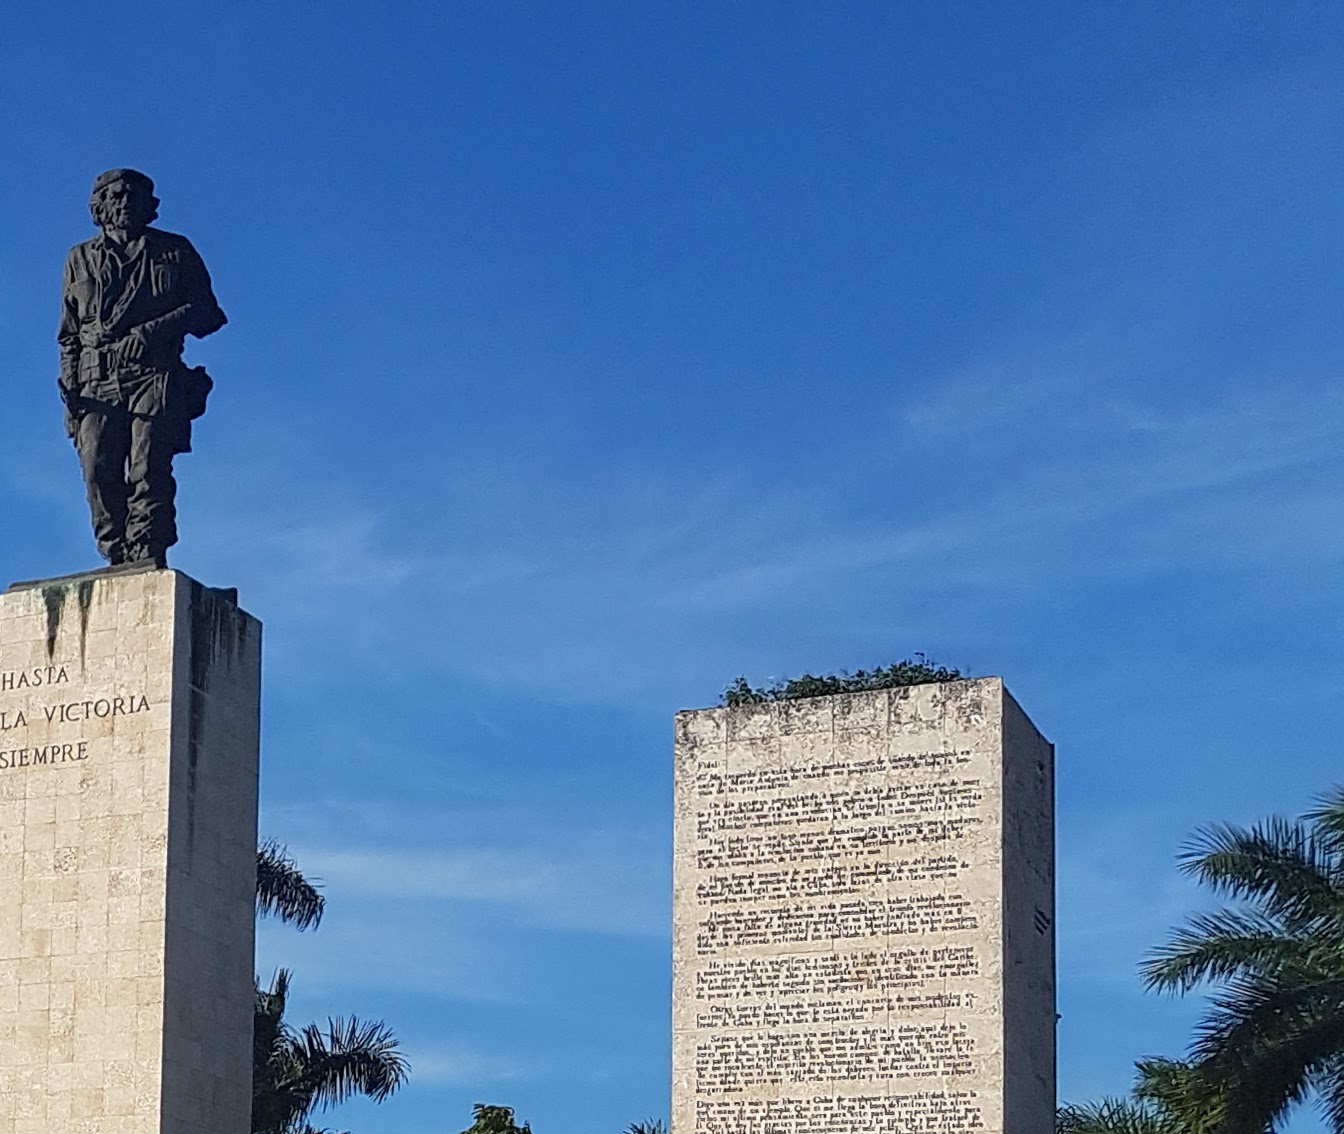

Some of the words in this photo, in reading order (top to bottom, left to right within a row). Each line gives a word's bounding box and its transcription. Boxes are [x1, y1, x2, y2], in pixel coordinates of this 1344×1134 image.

[2, 666, 69, 691] HASTA
[1, 711, 27, 731] LA
[44, 695, 151, 723] VICTORIA
